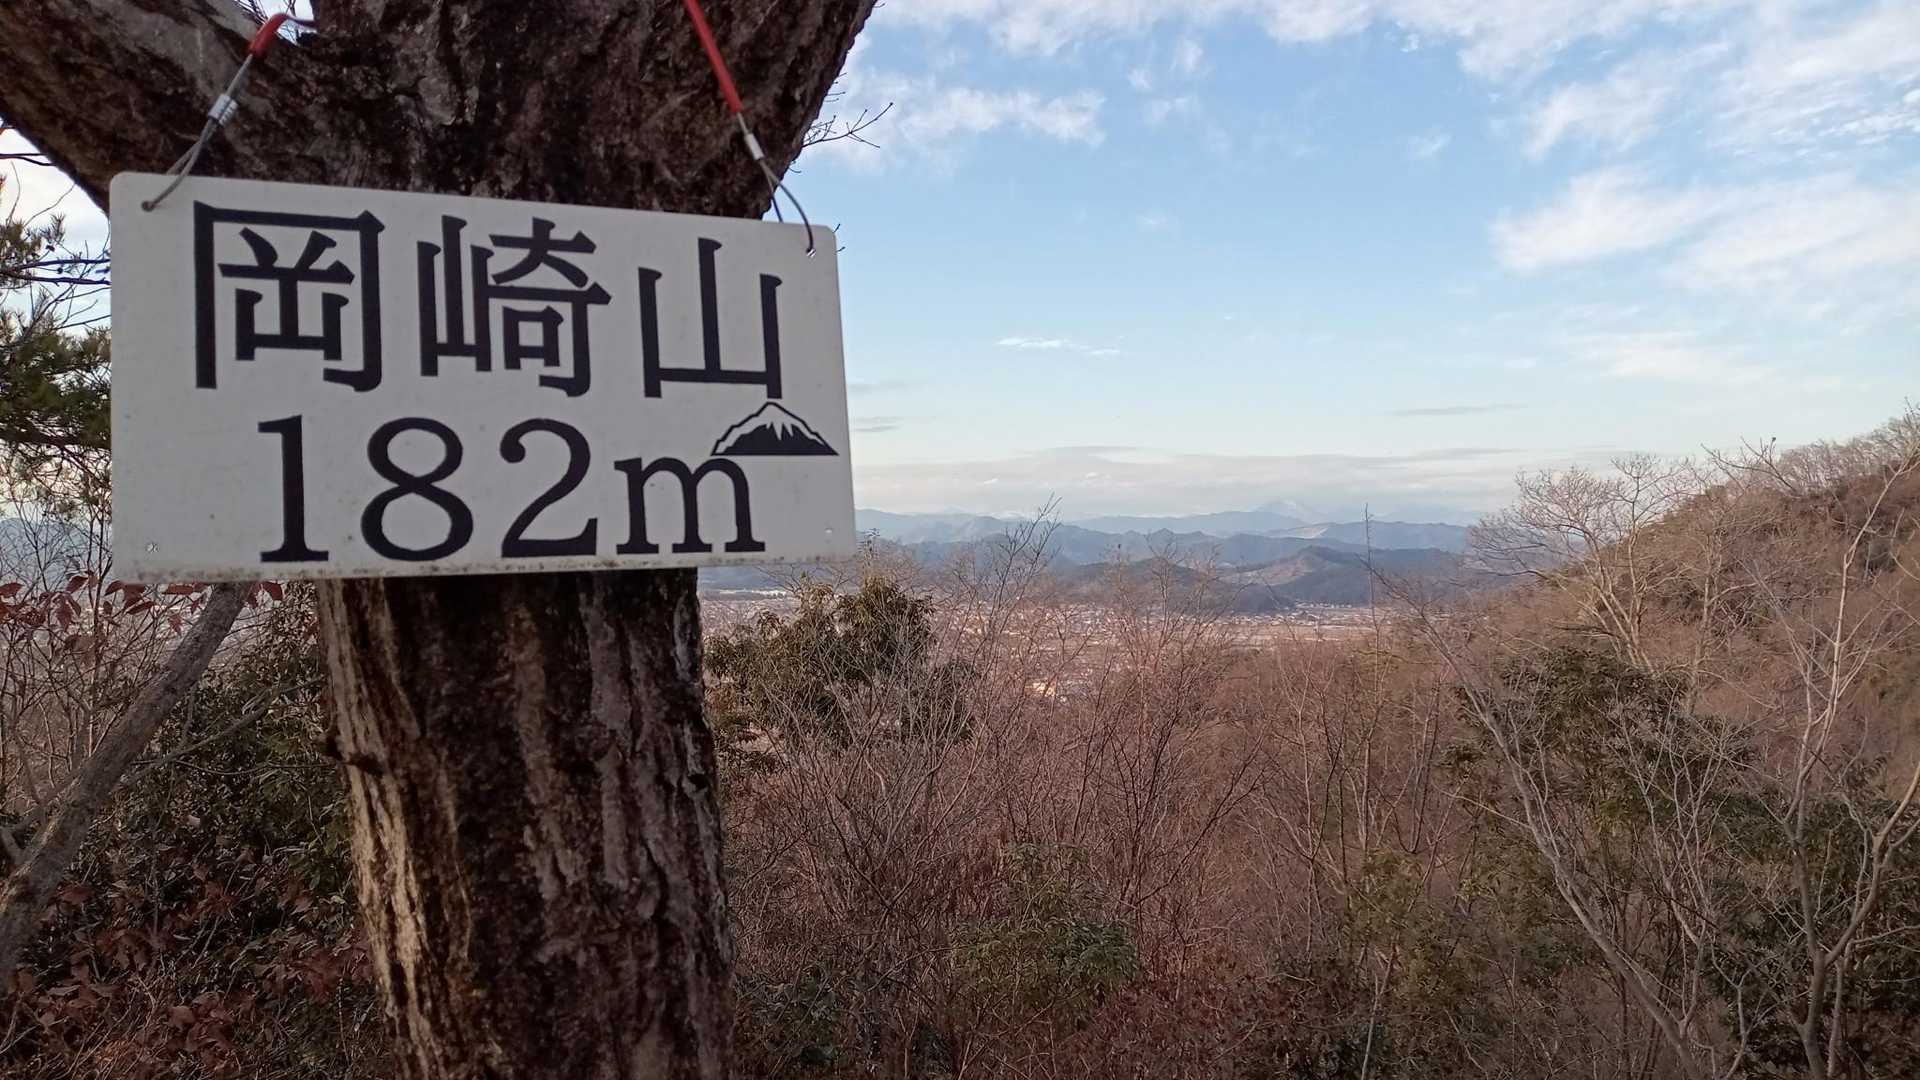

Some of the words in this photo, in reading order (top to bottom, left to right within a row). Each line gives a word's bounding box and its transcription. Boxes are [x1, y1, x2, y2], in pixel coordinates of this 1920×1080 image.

[192, 200, 784, 400] 岡崎山
[257, 414, 767, 564] 182m
